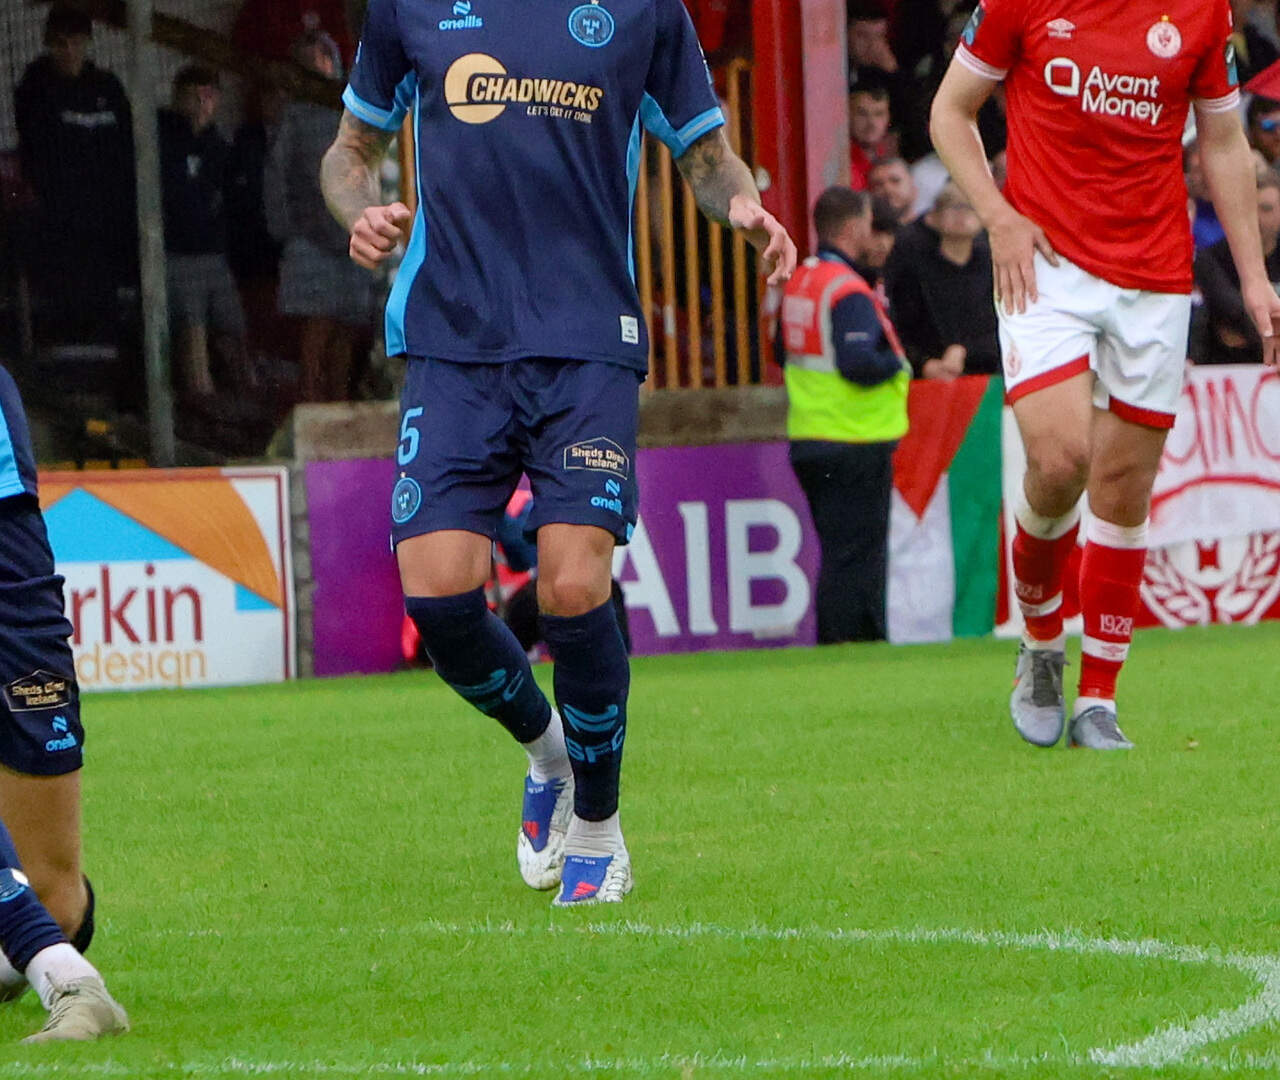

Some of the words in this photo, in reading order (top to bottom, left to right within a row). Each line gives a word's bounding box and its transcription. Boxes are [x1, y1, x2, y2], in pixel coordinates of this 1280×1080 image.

[471, 76, 604, 111] CHADWICKS
[1084, 66, 1160, 98] Avant
[1081, 88, 1163, 126] Money
[397, 406, 424, 466] 5
[571, 446, 604, 459] Sheds
[585, 457, 618, 469] Ireland
[71, 563, 204, 646] rkin
[1100, 613, 1133, 636] 1928
